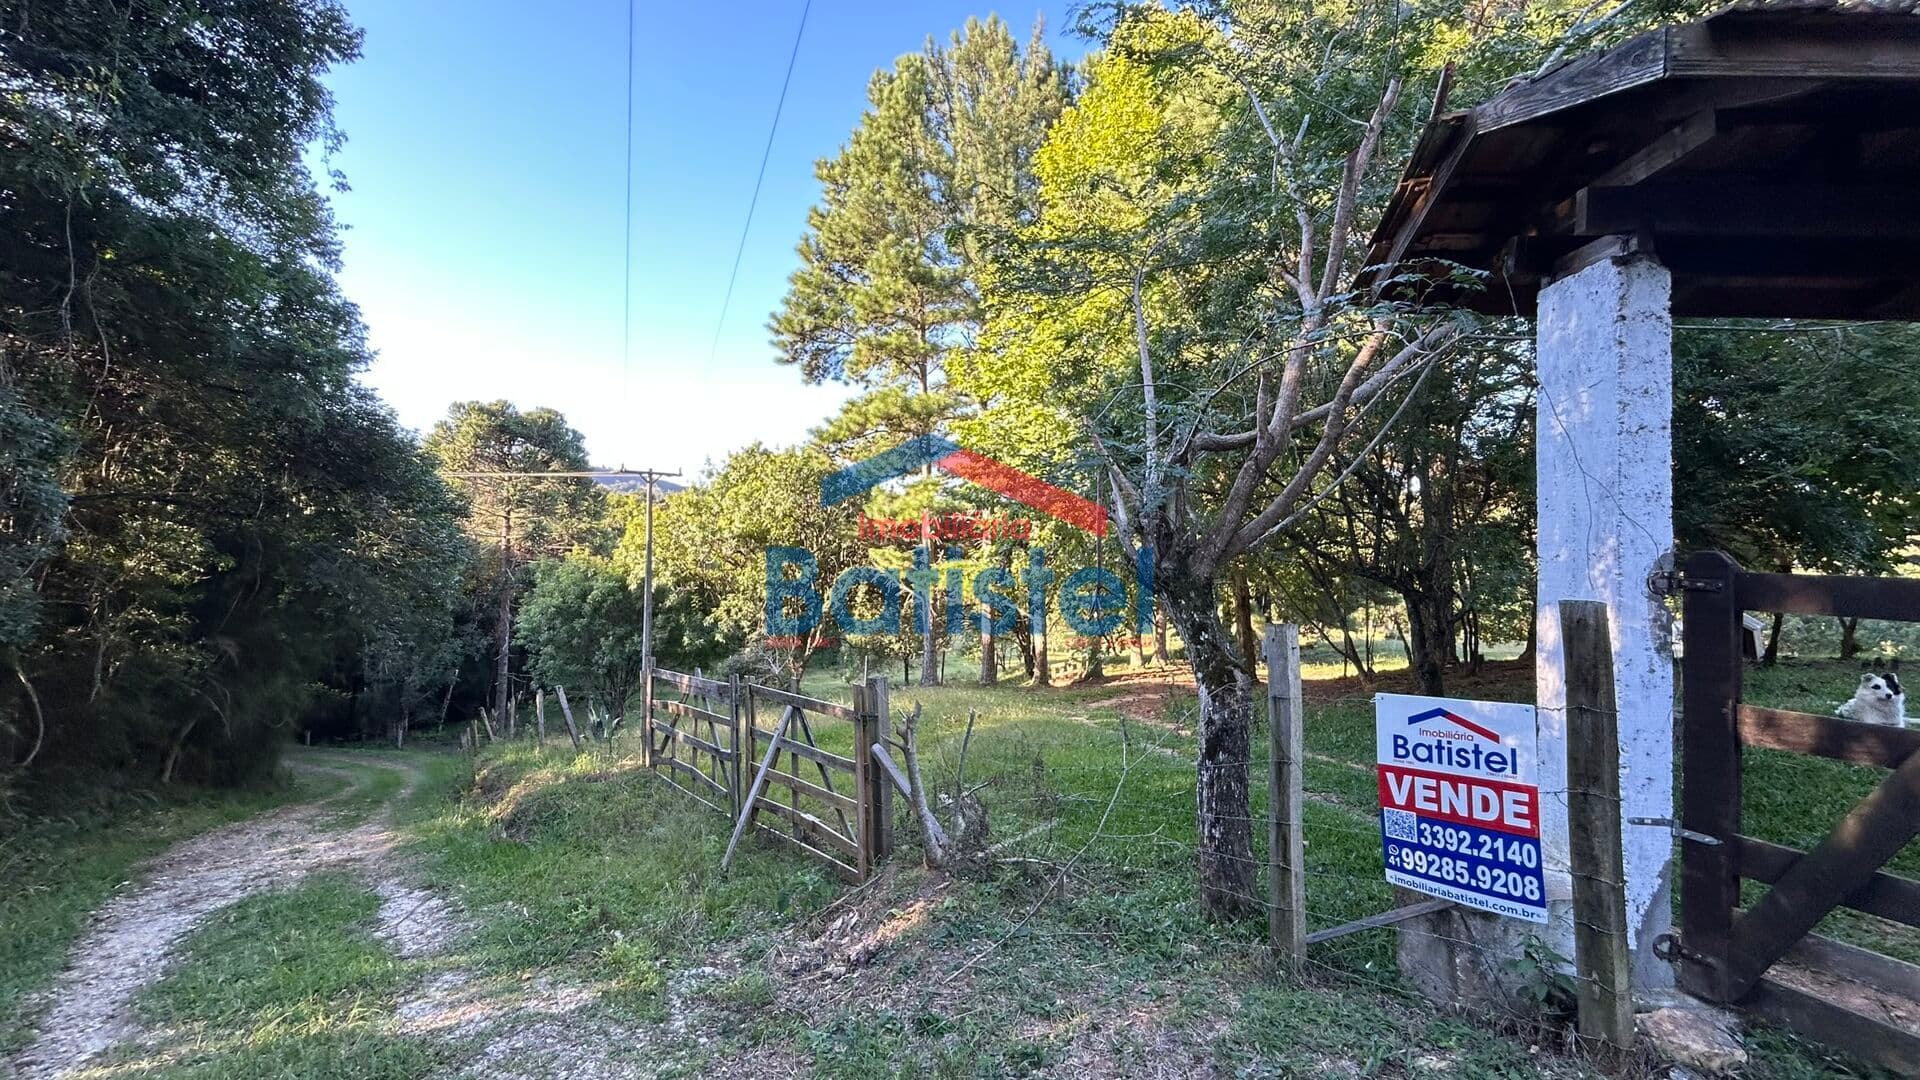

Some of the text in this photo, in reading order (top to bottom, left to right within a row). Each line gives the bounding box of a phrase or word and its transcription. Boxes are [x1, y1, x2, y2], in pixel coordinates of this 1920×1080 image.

[1393, 734, 1518, 775] Batistel
[1419, 727, 1474, 742] Imobiliária
[1385, 772, 1532, 829] VENDE
[1419, 823, 1538, 869] 3392.2140
[1388, 847, 1540, 901] 41 99285.9208
[1394, 874, 1537, 919] imobiliariabatistel.com.br
